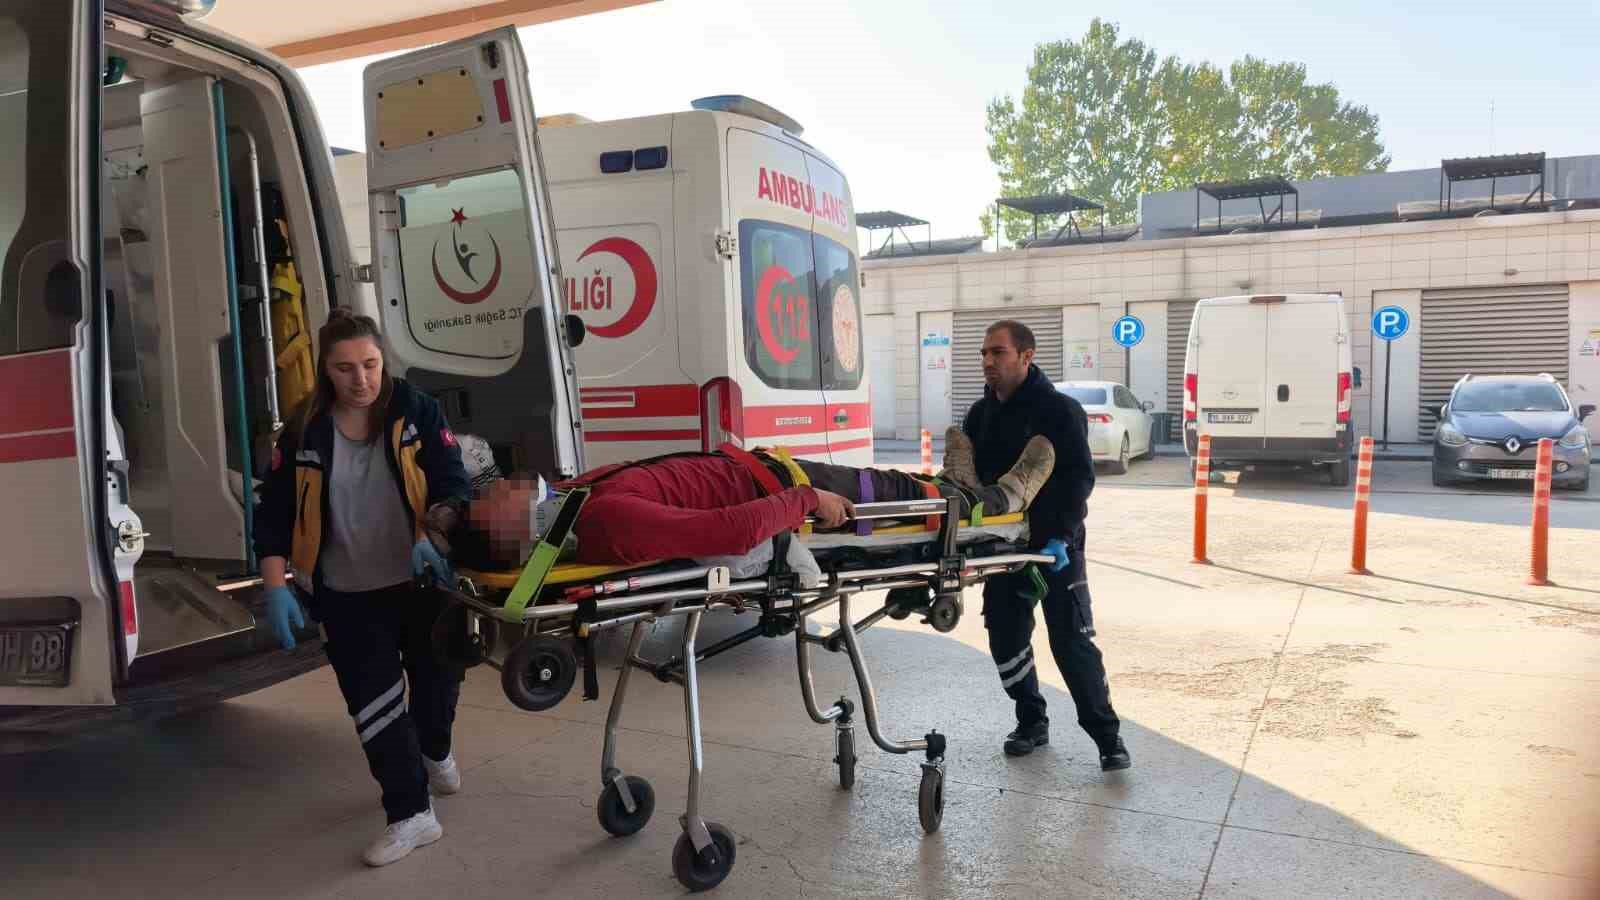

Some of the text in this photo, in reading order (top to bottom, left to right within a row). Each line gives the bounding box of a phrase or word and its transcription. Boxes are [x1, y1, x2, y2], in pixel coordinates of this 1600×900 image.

[757, 166, 848, 227] AMBULANS
[772, 291, 811, 340] 112
[1120, 320, 1137, 342] P
[1380, 311, 1400, 335] P
[31, 634, 63, 672] 98
